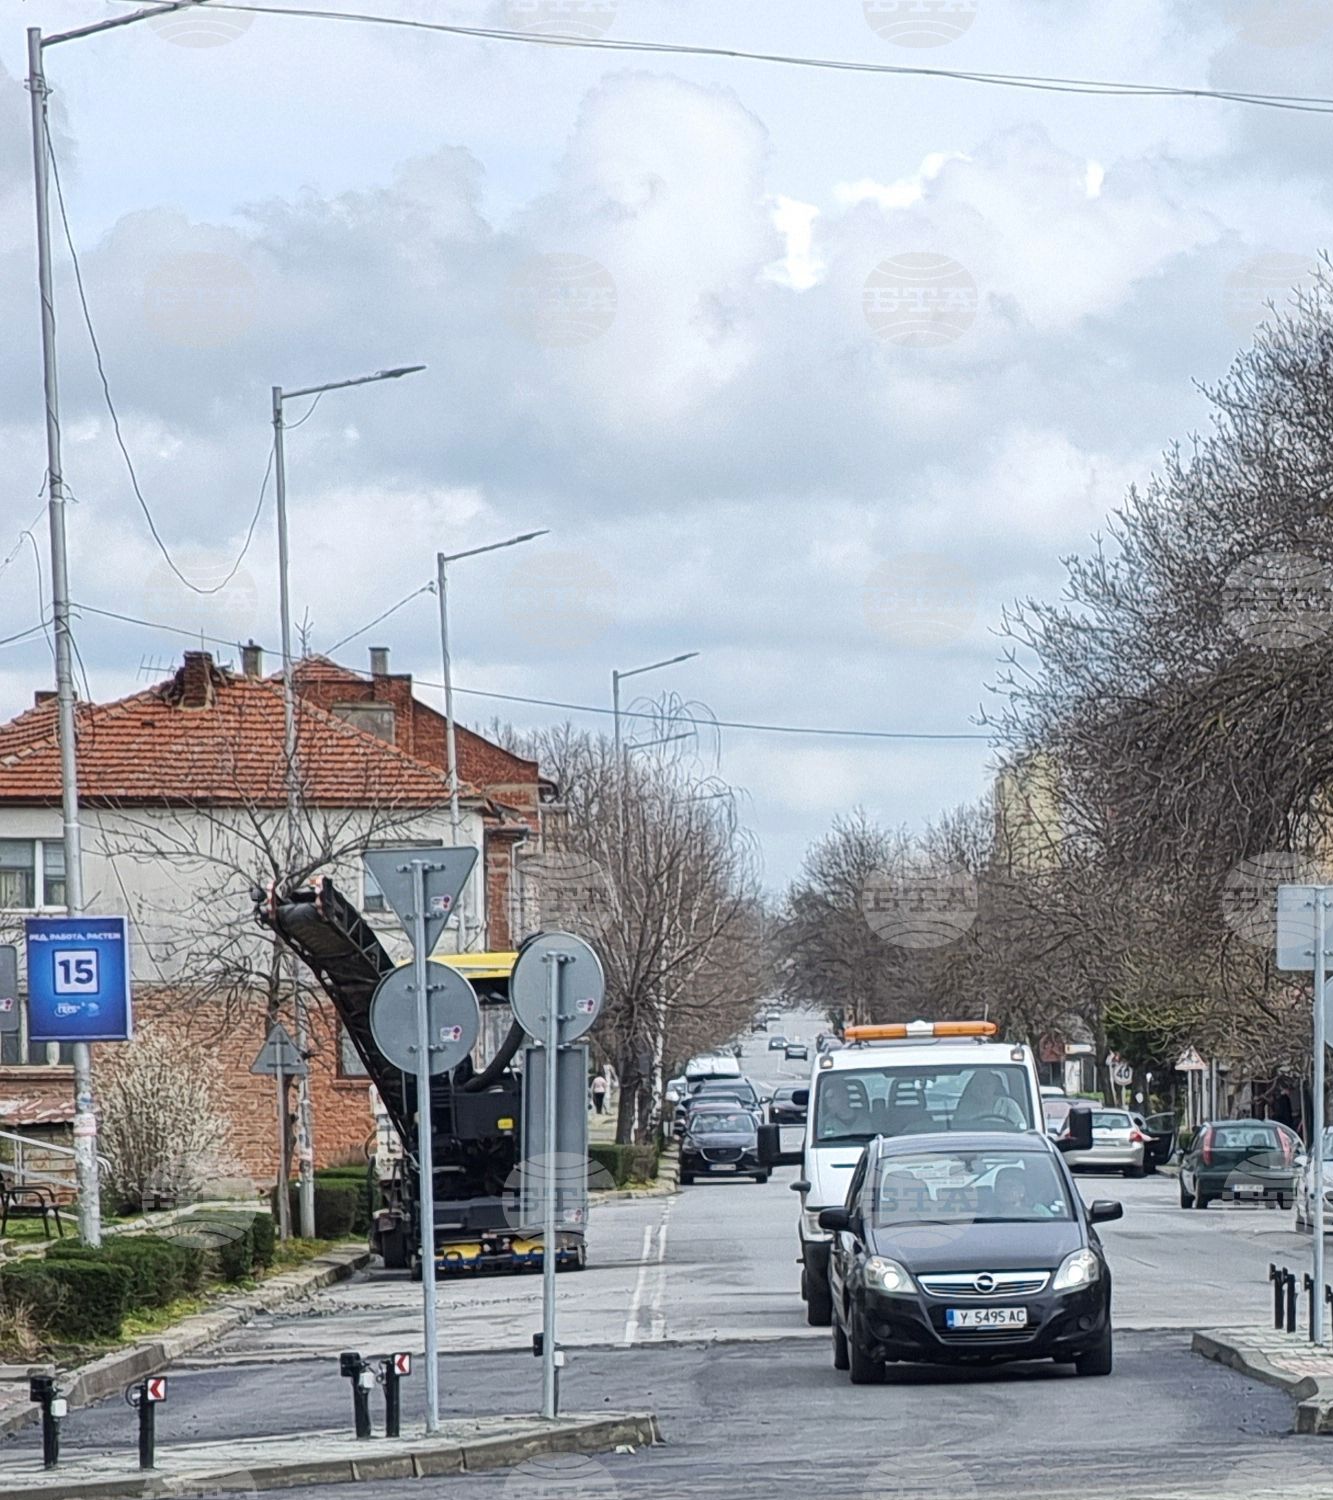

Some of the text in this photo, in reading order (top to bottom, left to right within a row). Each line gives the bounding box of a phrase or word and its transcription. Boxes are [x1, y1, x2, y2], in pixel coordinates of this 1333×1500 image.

[58, 959, 94, 985] 15
[975, 1310, 1006, 1324] 5495
[1008, 1310, 1025, 1323] AC
